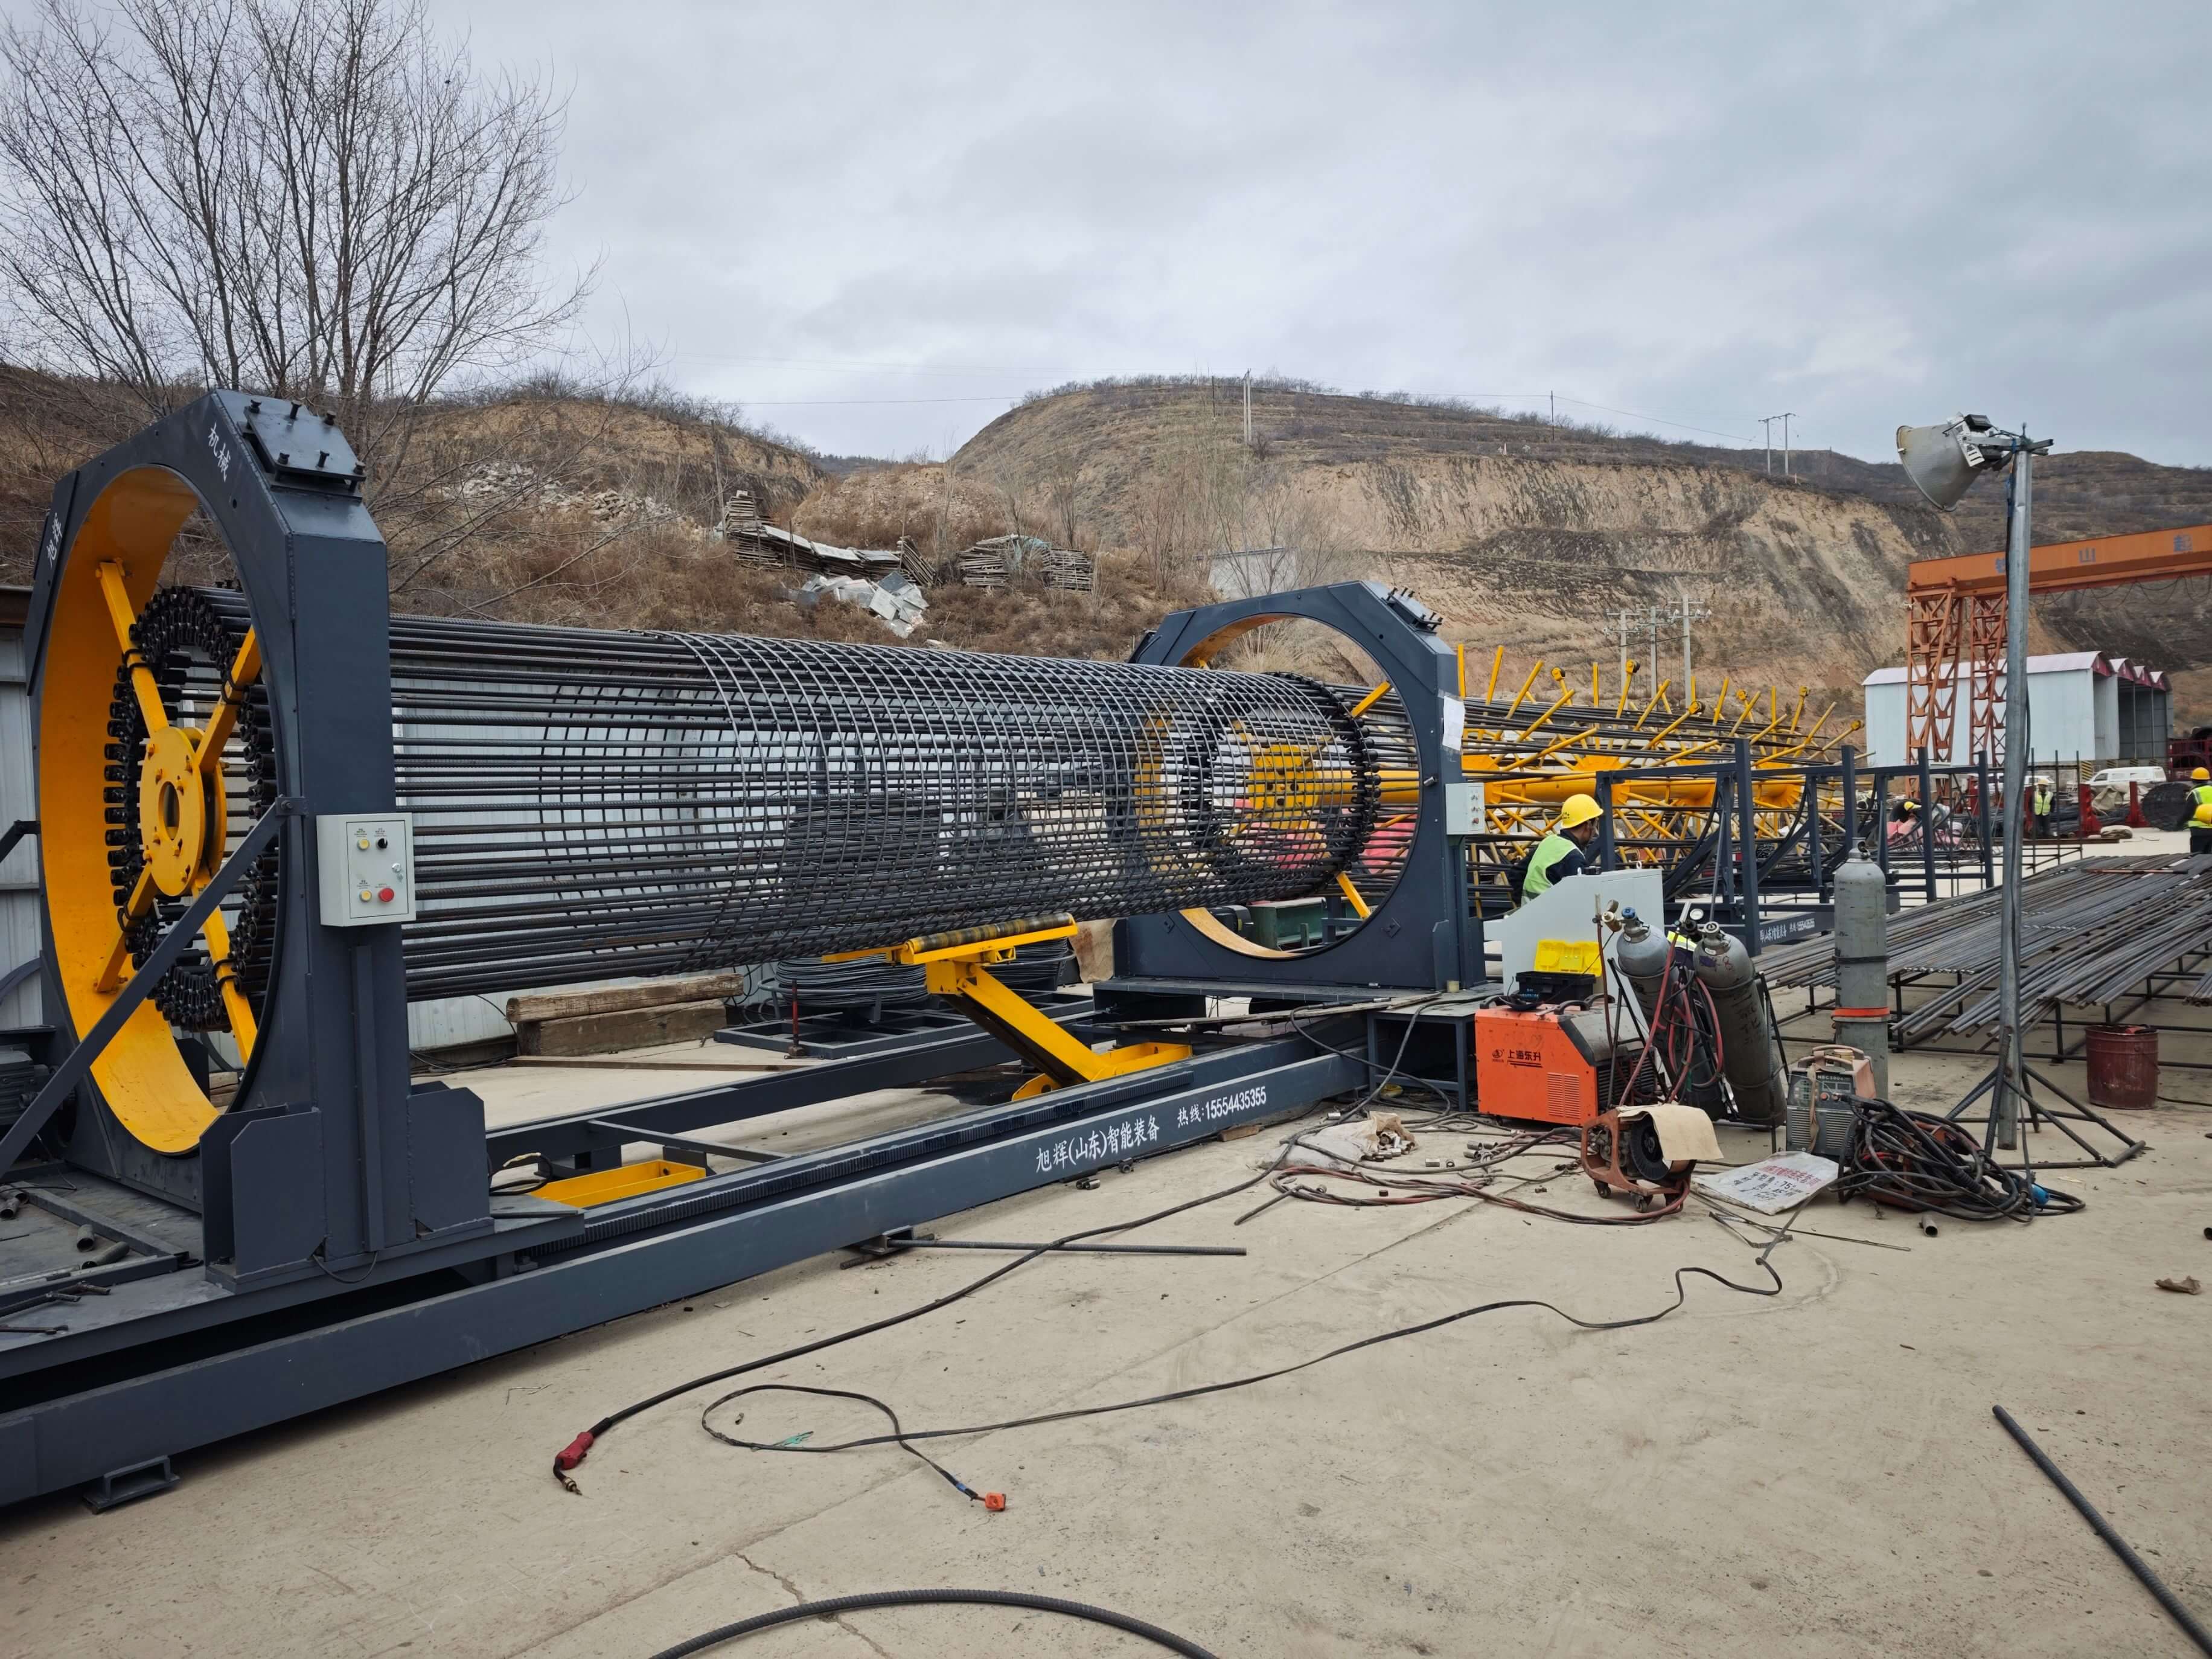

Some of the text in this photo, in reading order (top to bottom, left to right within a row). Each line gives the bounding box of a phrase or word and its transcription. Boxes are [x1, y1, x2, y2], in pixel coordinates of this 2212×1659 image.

[208, 422, 231, 482] 机械
[46, 513, 62, 568] 旭辉
[1507, 1049, 1541, 1061] 上海东升
[1035, 1114, 1160, 1174] 旭辉(山东)智能装备
